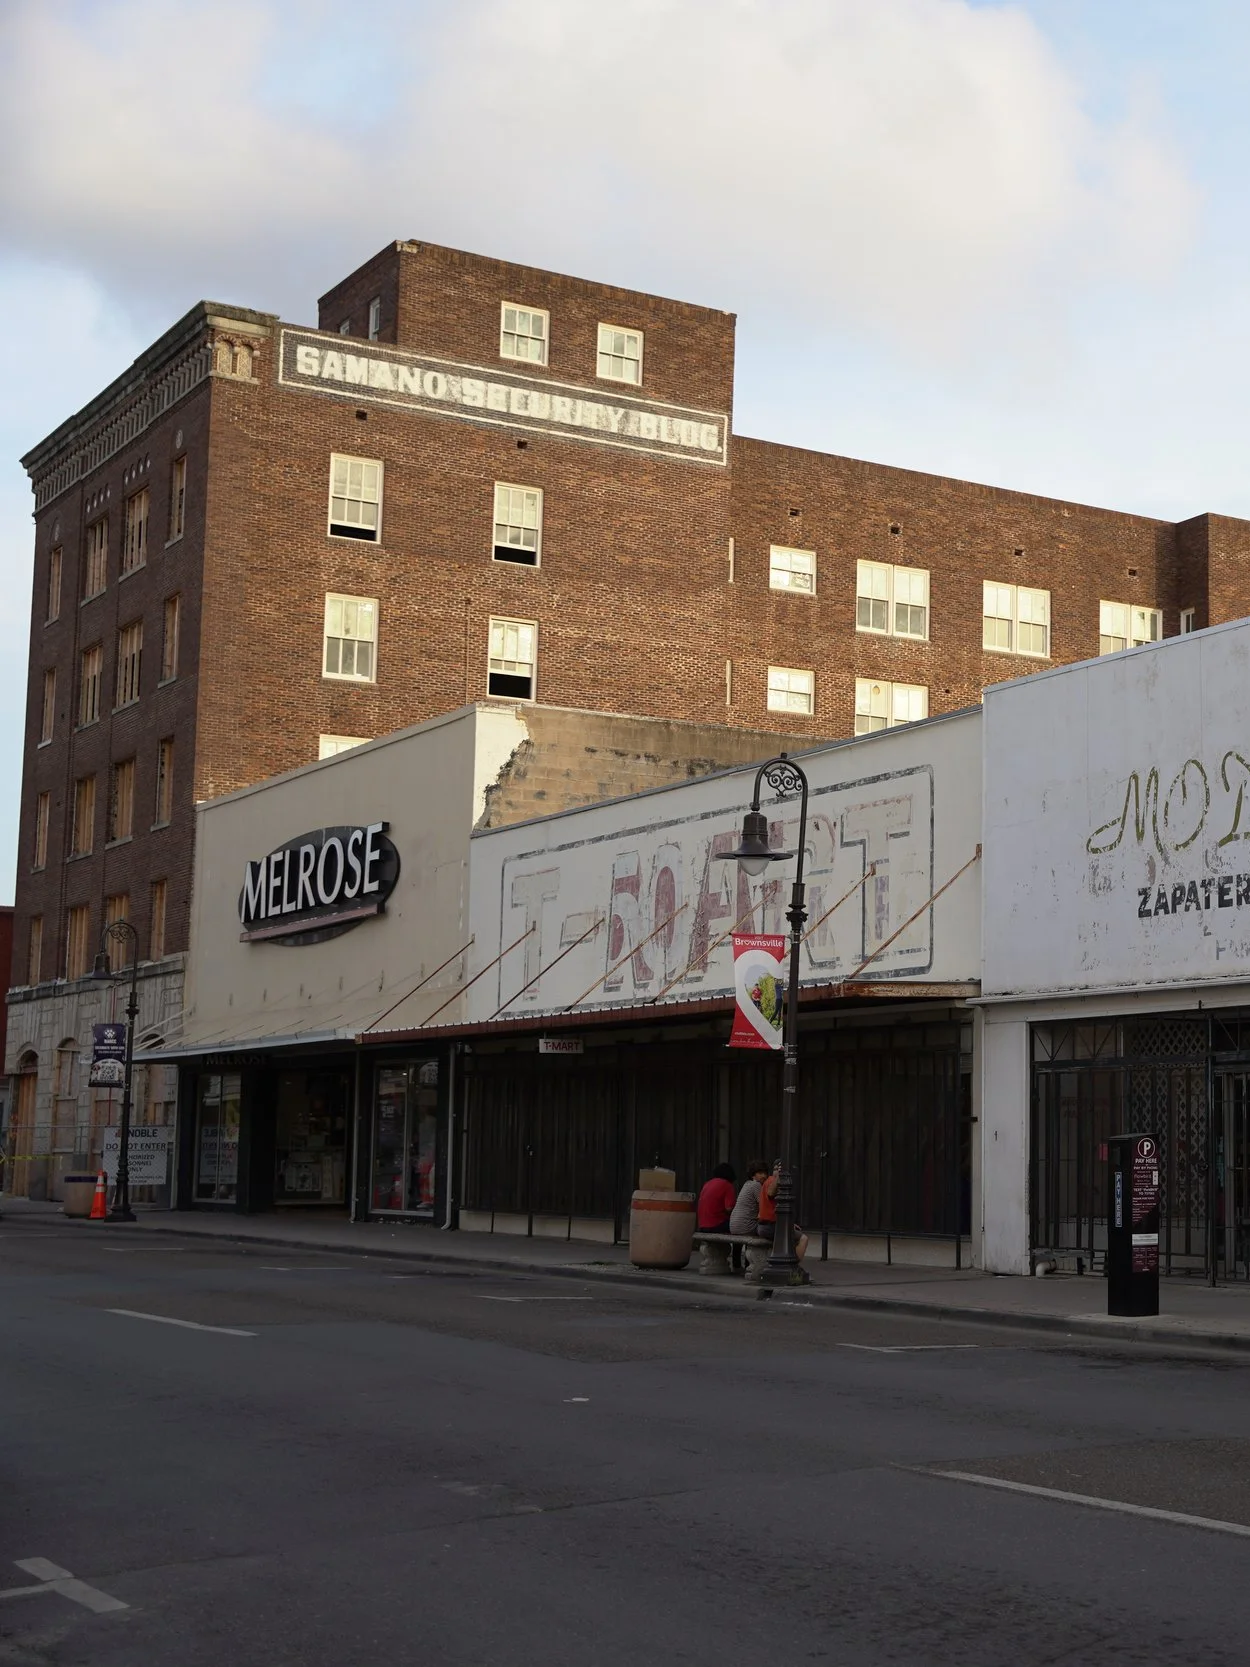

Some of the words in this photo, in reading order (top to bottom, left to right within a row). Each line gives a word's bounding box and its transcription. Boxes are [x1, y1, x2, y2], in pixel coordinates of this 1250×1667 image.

[296, 344, 448, 399] SAMANO
[460, 376, 626, 436] SECURITY
[240, 821, 387, 924] MELROSE
[543, 1041, 581, 1051] T-MART
[206, 1053, 268, 1066] MELROSE
[128, 1129, 158, 1137] NOBLE
[140, 1142, 166, 1150] ENTER
[1143, 1141, 1152, 1155] P
